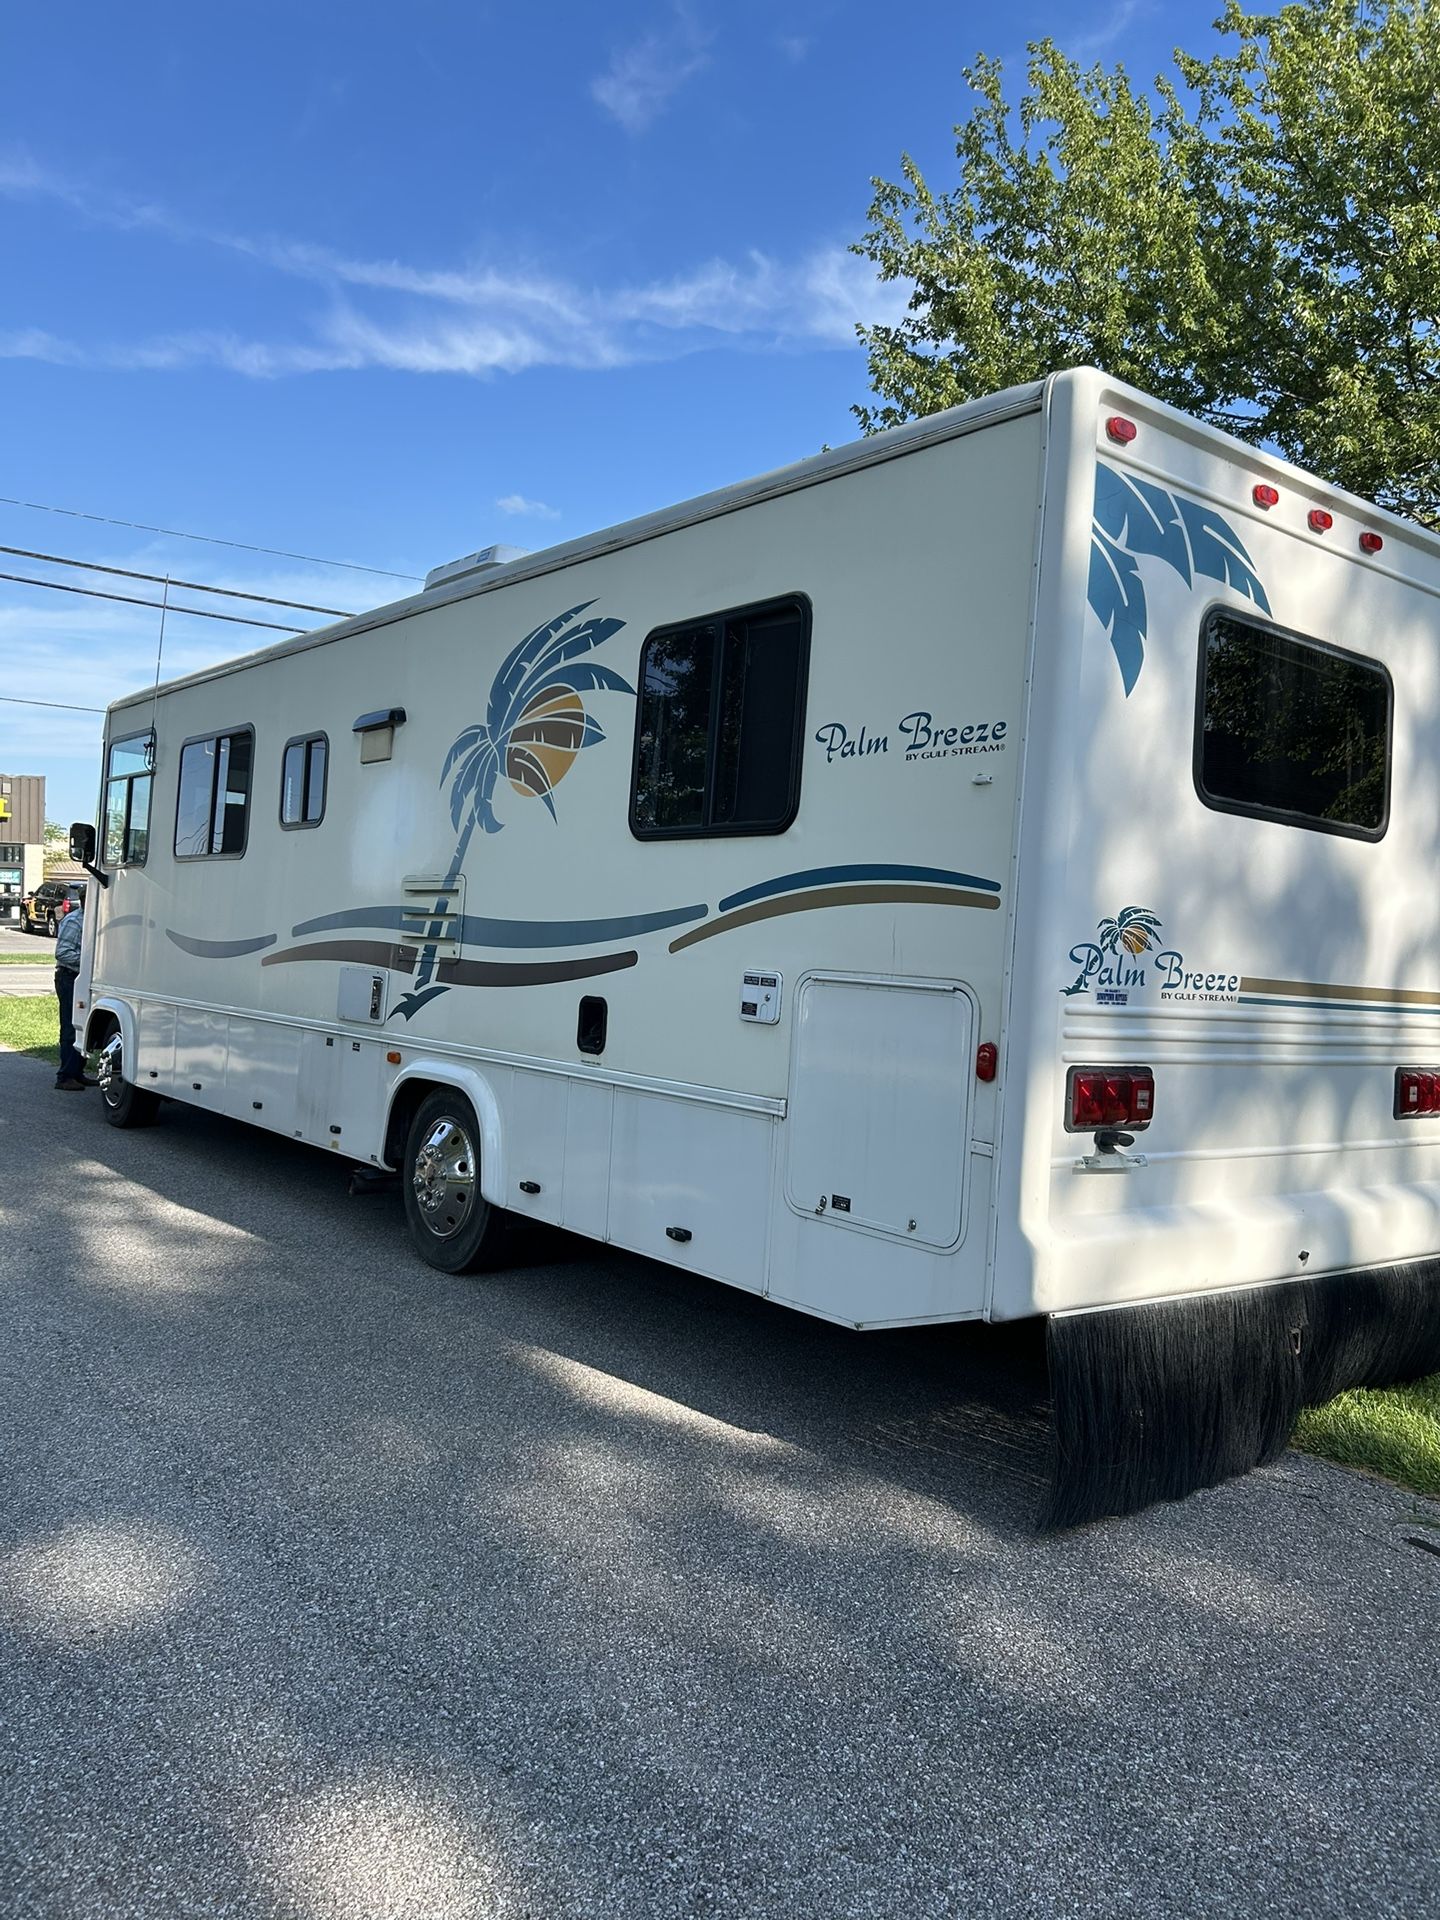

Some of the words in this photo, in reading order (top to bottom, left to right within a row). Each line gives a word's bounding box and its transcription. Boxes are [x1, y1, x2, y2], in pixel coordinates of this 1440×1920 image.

[815, 723, 888, 763] Palm
[899, 711, 1007, 752] Breeze
[905, 753, 919, 761] BY
[921, 749, 949, 760] GULF
[1069, 943, 1145, 988] Palm
[1154, 951, 1238, 992] Breeze
[1160, 992, 1173, 1000] BY
[1174, 992, 1197, 1001] GULF
